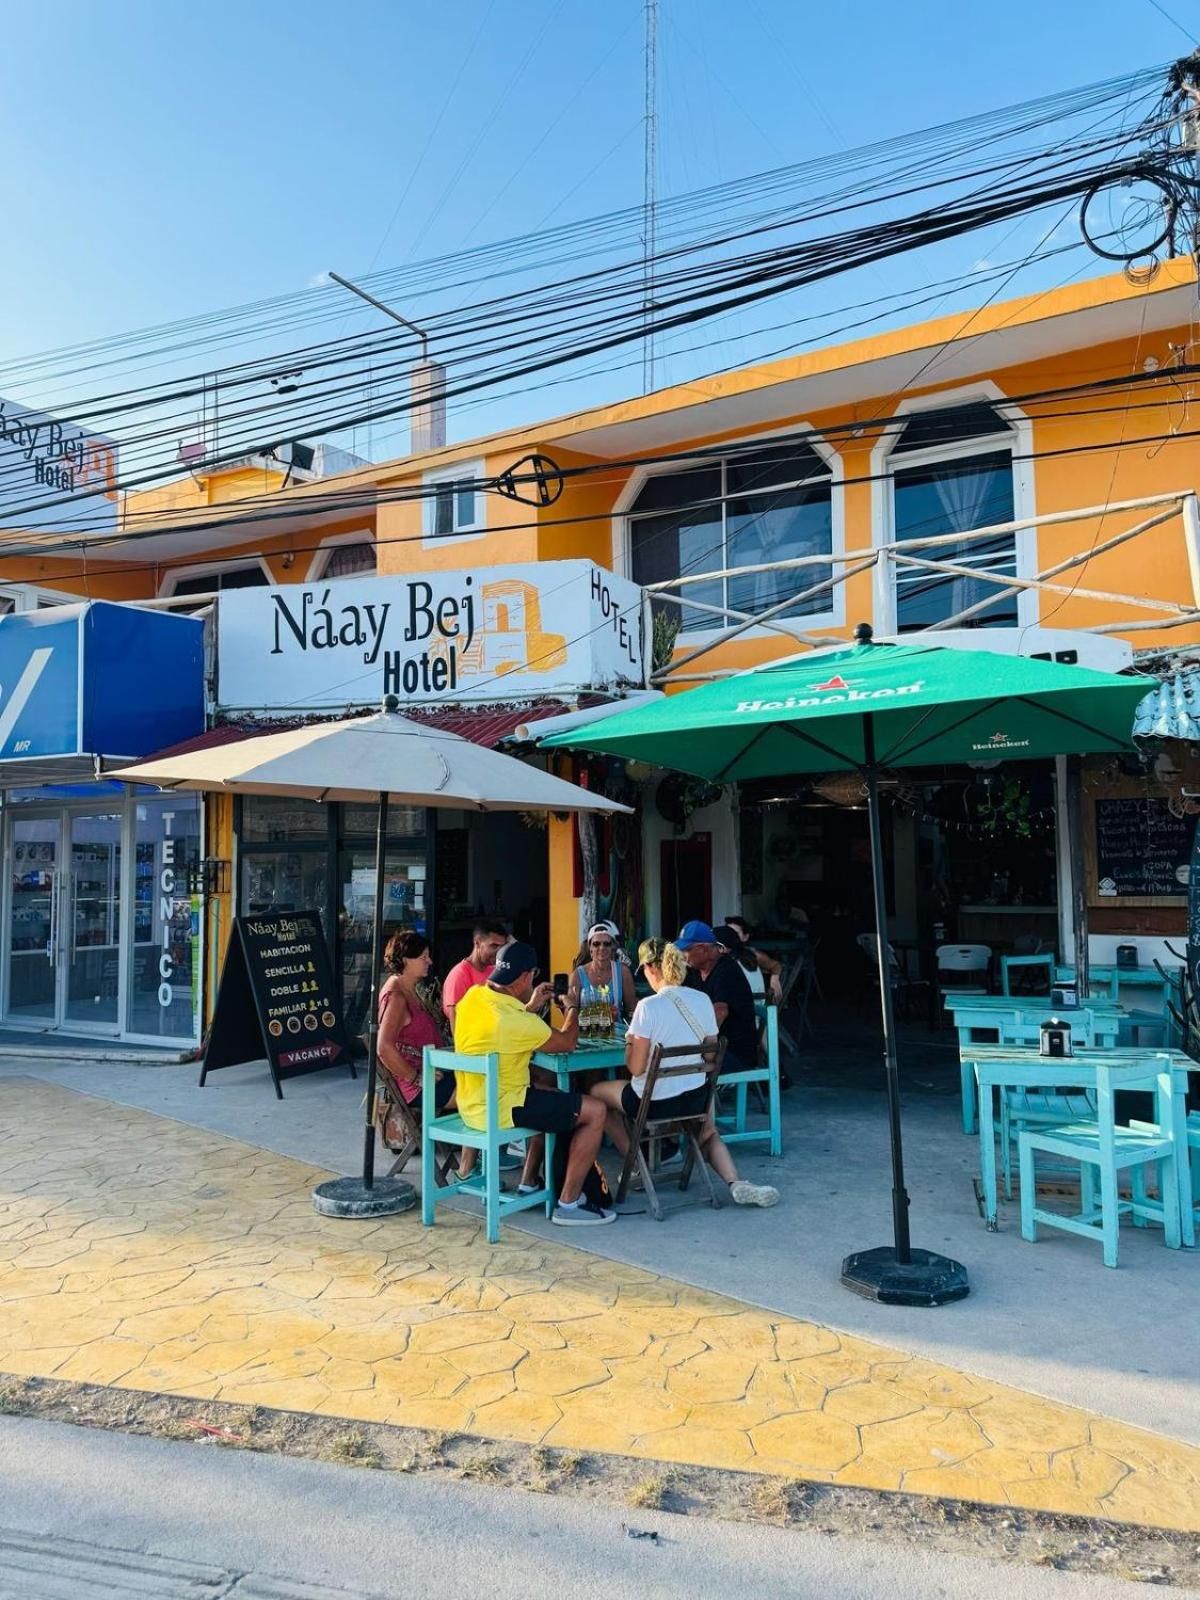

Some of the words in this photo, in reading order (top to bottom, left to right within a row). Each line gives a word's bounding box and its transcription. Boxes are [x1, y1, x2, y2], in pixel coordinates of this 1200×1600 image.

[47, 423, 83, 475] Bej
[35, 456, 74, 493] Hotel
[270, 588, 390, 664] Náay
[404, 576, 475, 653] Bej
[591, 567, 637, 664] HOTEL
[383, 645, 457, 694] Hotel
[735, 682, 922, 713] Heineken
[973, 740, 1028, 750] Heineken
[158, 812, 175, 1007] TECNICO
[247, 921, 277, 937] Náay
[260, 944, 311, 959] HABITACION
[264, 963, 305, 978] SENCILLA
[270, 984, 299, 997] DOBLE
[268, 1002, 307, 1017] FAMILIAR
[287, 1047, 332, 1062] VACANCY
